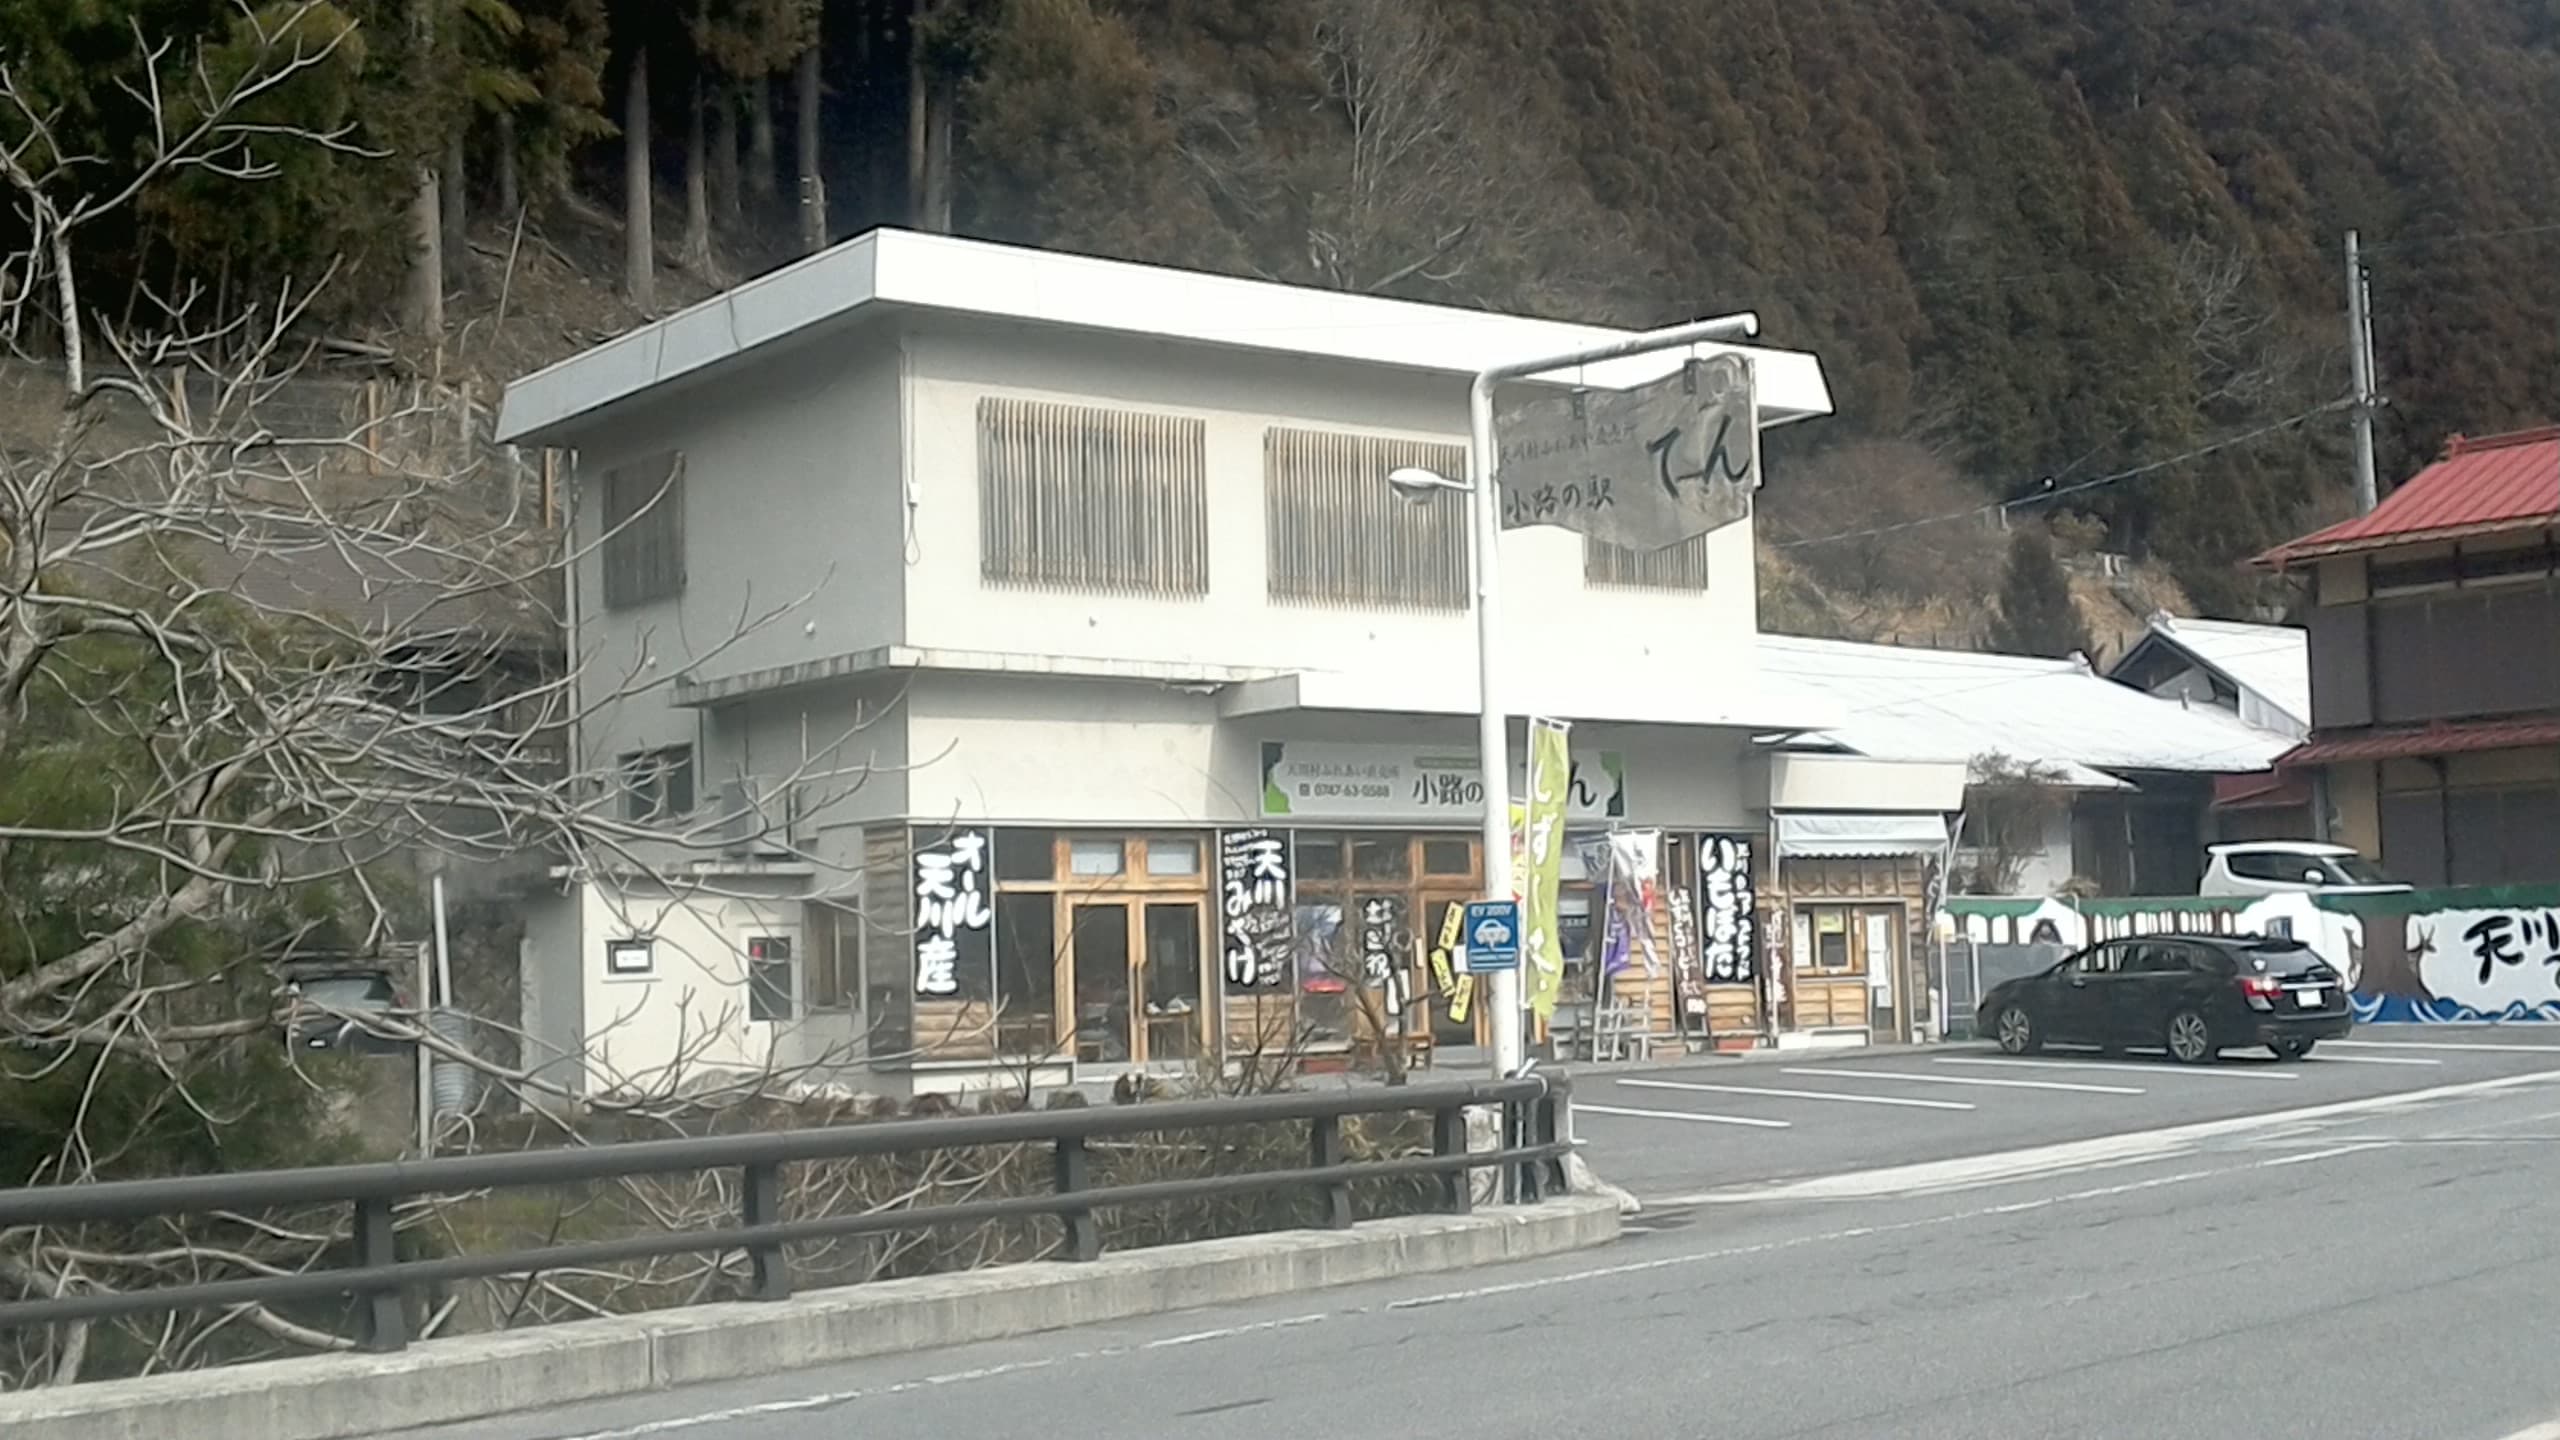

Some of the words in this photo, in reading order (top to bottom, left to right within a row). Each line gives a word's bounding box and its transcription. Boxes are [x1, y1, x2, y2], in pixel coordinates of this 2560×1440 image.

[1647, 415, 1750, 500] てん
[951, 831, 990, 930] オール
[1252, 839, 1286, 910] 天川
[916, 852, 958, 994] 天川産
